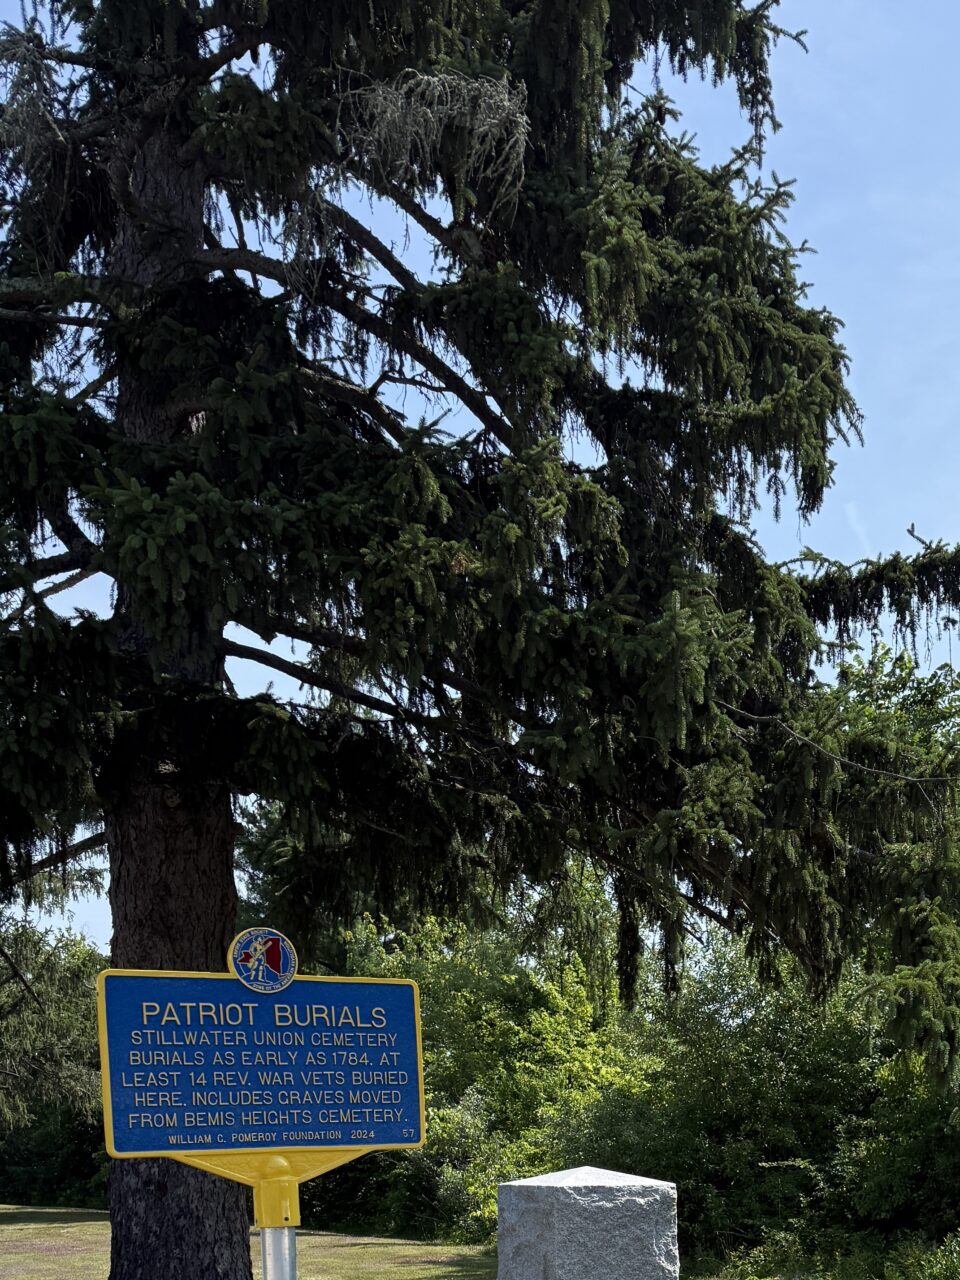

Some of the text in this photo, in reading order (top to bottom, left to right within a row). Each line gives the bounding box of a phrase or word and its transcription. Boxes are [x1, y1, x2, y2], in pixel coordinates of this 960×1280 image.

[142, 1002, 387, 1028] PATRIOT BURIALS
[131, 1030, 398, 1046] STILLWATER UNION CEMETERY
[129, 1050, 400, 1066] BURIALS AS EARLY AS 1784. AT
[122, 1070, 409, 1087] LEAST 14 REV. WAR VETS BURIED
[134, 1090, 402, 1107] HERE. INCLUDES GRAVES MOVED
[128, 1108, 408, 1128] FROM BEMIS HEIGHTS CEMETERY.
[168, 1130, 376, 1144] WILLIAM C. POMEROY FOUNDATION 2024
[402, 1128, 415, 1138] 57
